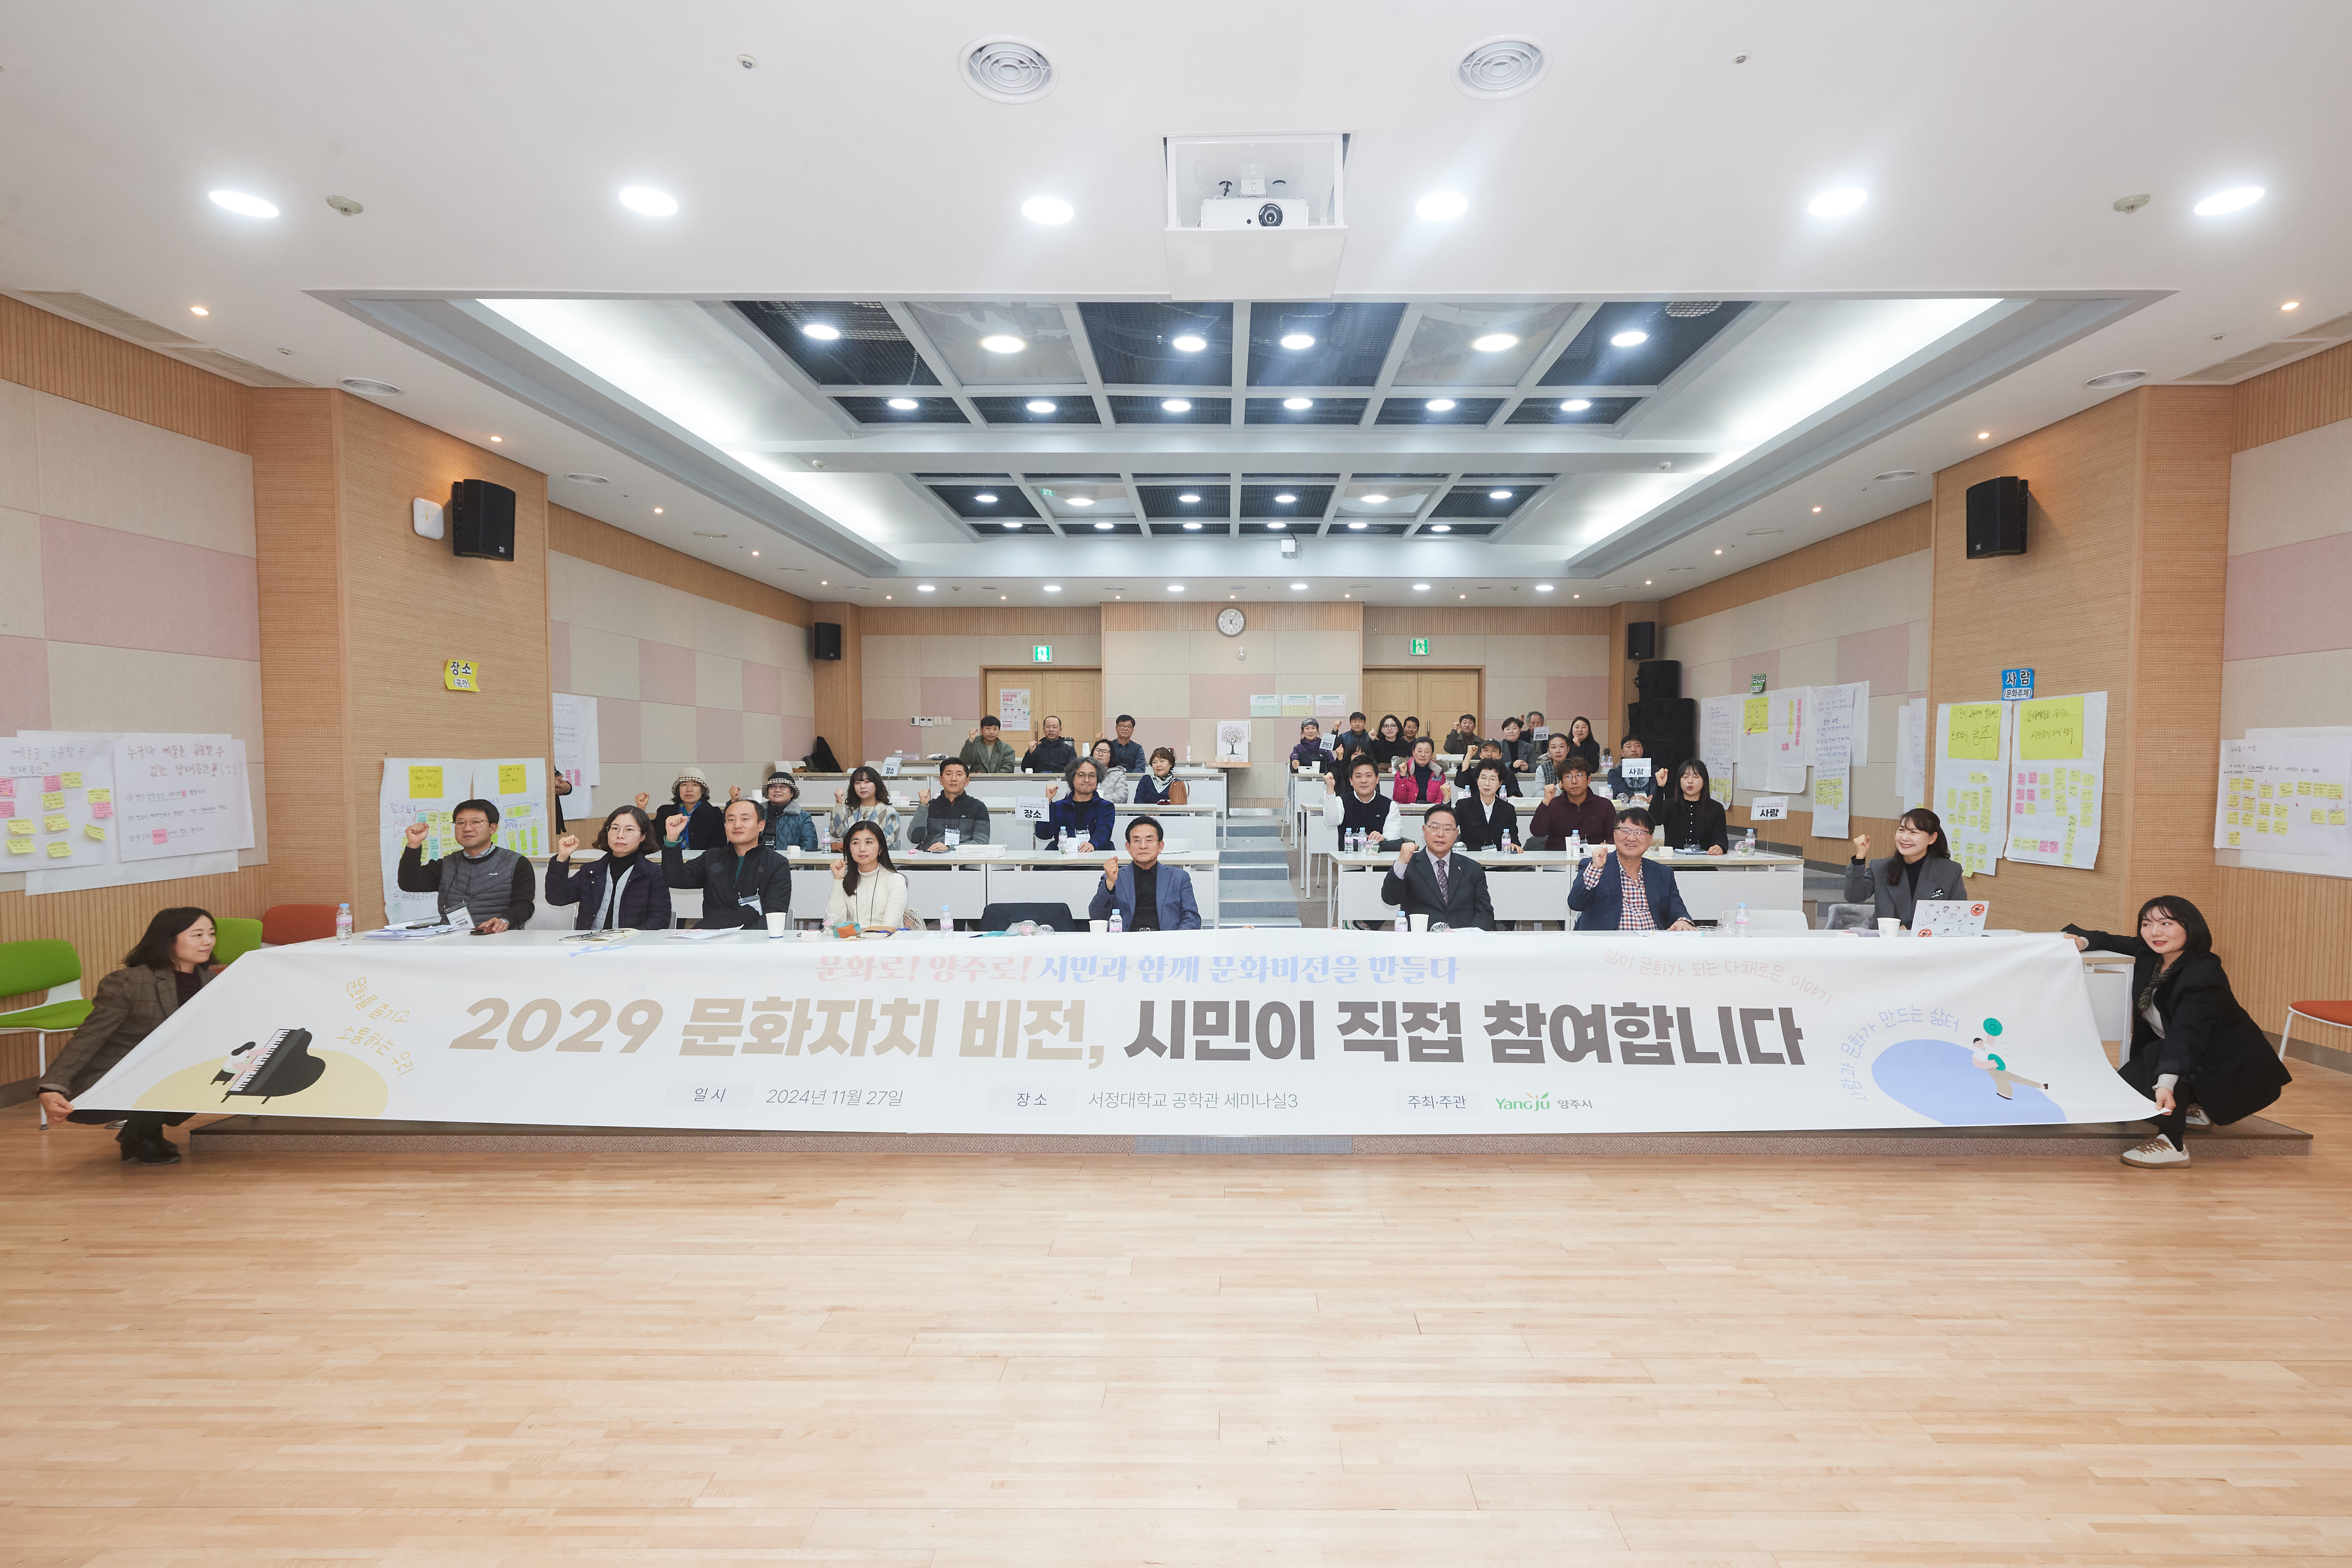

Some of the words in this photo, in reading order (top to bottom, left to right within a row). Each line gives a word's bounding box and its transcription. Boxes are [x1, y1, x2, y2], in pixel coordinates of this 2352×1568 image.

[451, 662, 471, 675] 장소
[2007, 670, 2030, 686] 사람
[454, 679, 470, 688] (공간)
[1753, 675, 1765, 684] 콘텐츠
[2004, 689, 2031, 698] (문화주체)
[1024, 809, 1042, 819] 장소
[1760, 808, 1780, 817] 사람
[815, 955, 919, 983] 문화로!
[928, 955, 1032, 983] 양주로!
[1037, 955, 1130, 983] 시민과
[1137, 955, 1199, 984] 함께
[1208, 955, 1360, 984] 문화비전을
[1370, 955, 1461, 985] 만들다
[1604, 948, 1634, 970] 삶이
[1639, 957, 1684, 977] 문화가
[1692, 959, 1719, 977] 되는
[1725, 960, 1784, 983] 다채로운
[1791, 975, 1832, 1006] 이야기
[369, 1003, 410, 1022] 즐기고
[1878, 1004, 1923, 1028] 만드는
[1930, 1007, 1960, 1032] 삶터
[448, 997, 664, 1054] 2029
[678, 996, 940, 1057] 문화자치
[958, 999, 1104, 1069] 비전,
[1123, 1000, 1315, 1061] 시민이
[1336, 1001, 1465, 1062] 직접
[1483, 1000, 1806, 1065] 참여합니다
[1840, 1022, 1876, 1059] 문화가
[336, 1026, 394, 1055] 소통하는
[391, 1052, 415, 1076] 우리
[1840, 1062, 1870, 1102] 사람과
[766, 1089, 827, 1106] 2024년
[831, 1089, 863, 1106] 11월
[866, 1090, 904, 1107] 27일
[1088, 1091, 1168, 1109] 서정대학교
[1172, 1092, 1219, 1109] 공학관
[1223, 1093, 1298, 1110] 세미나실3
[1495, 1091, 1550, 1112] Yangju
[1557, 1098, 1593, 1110] 양주시
